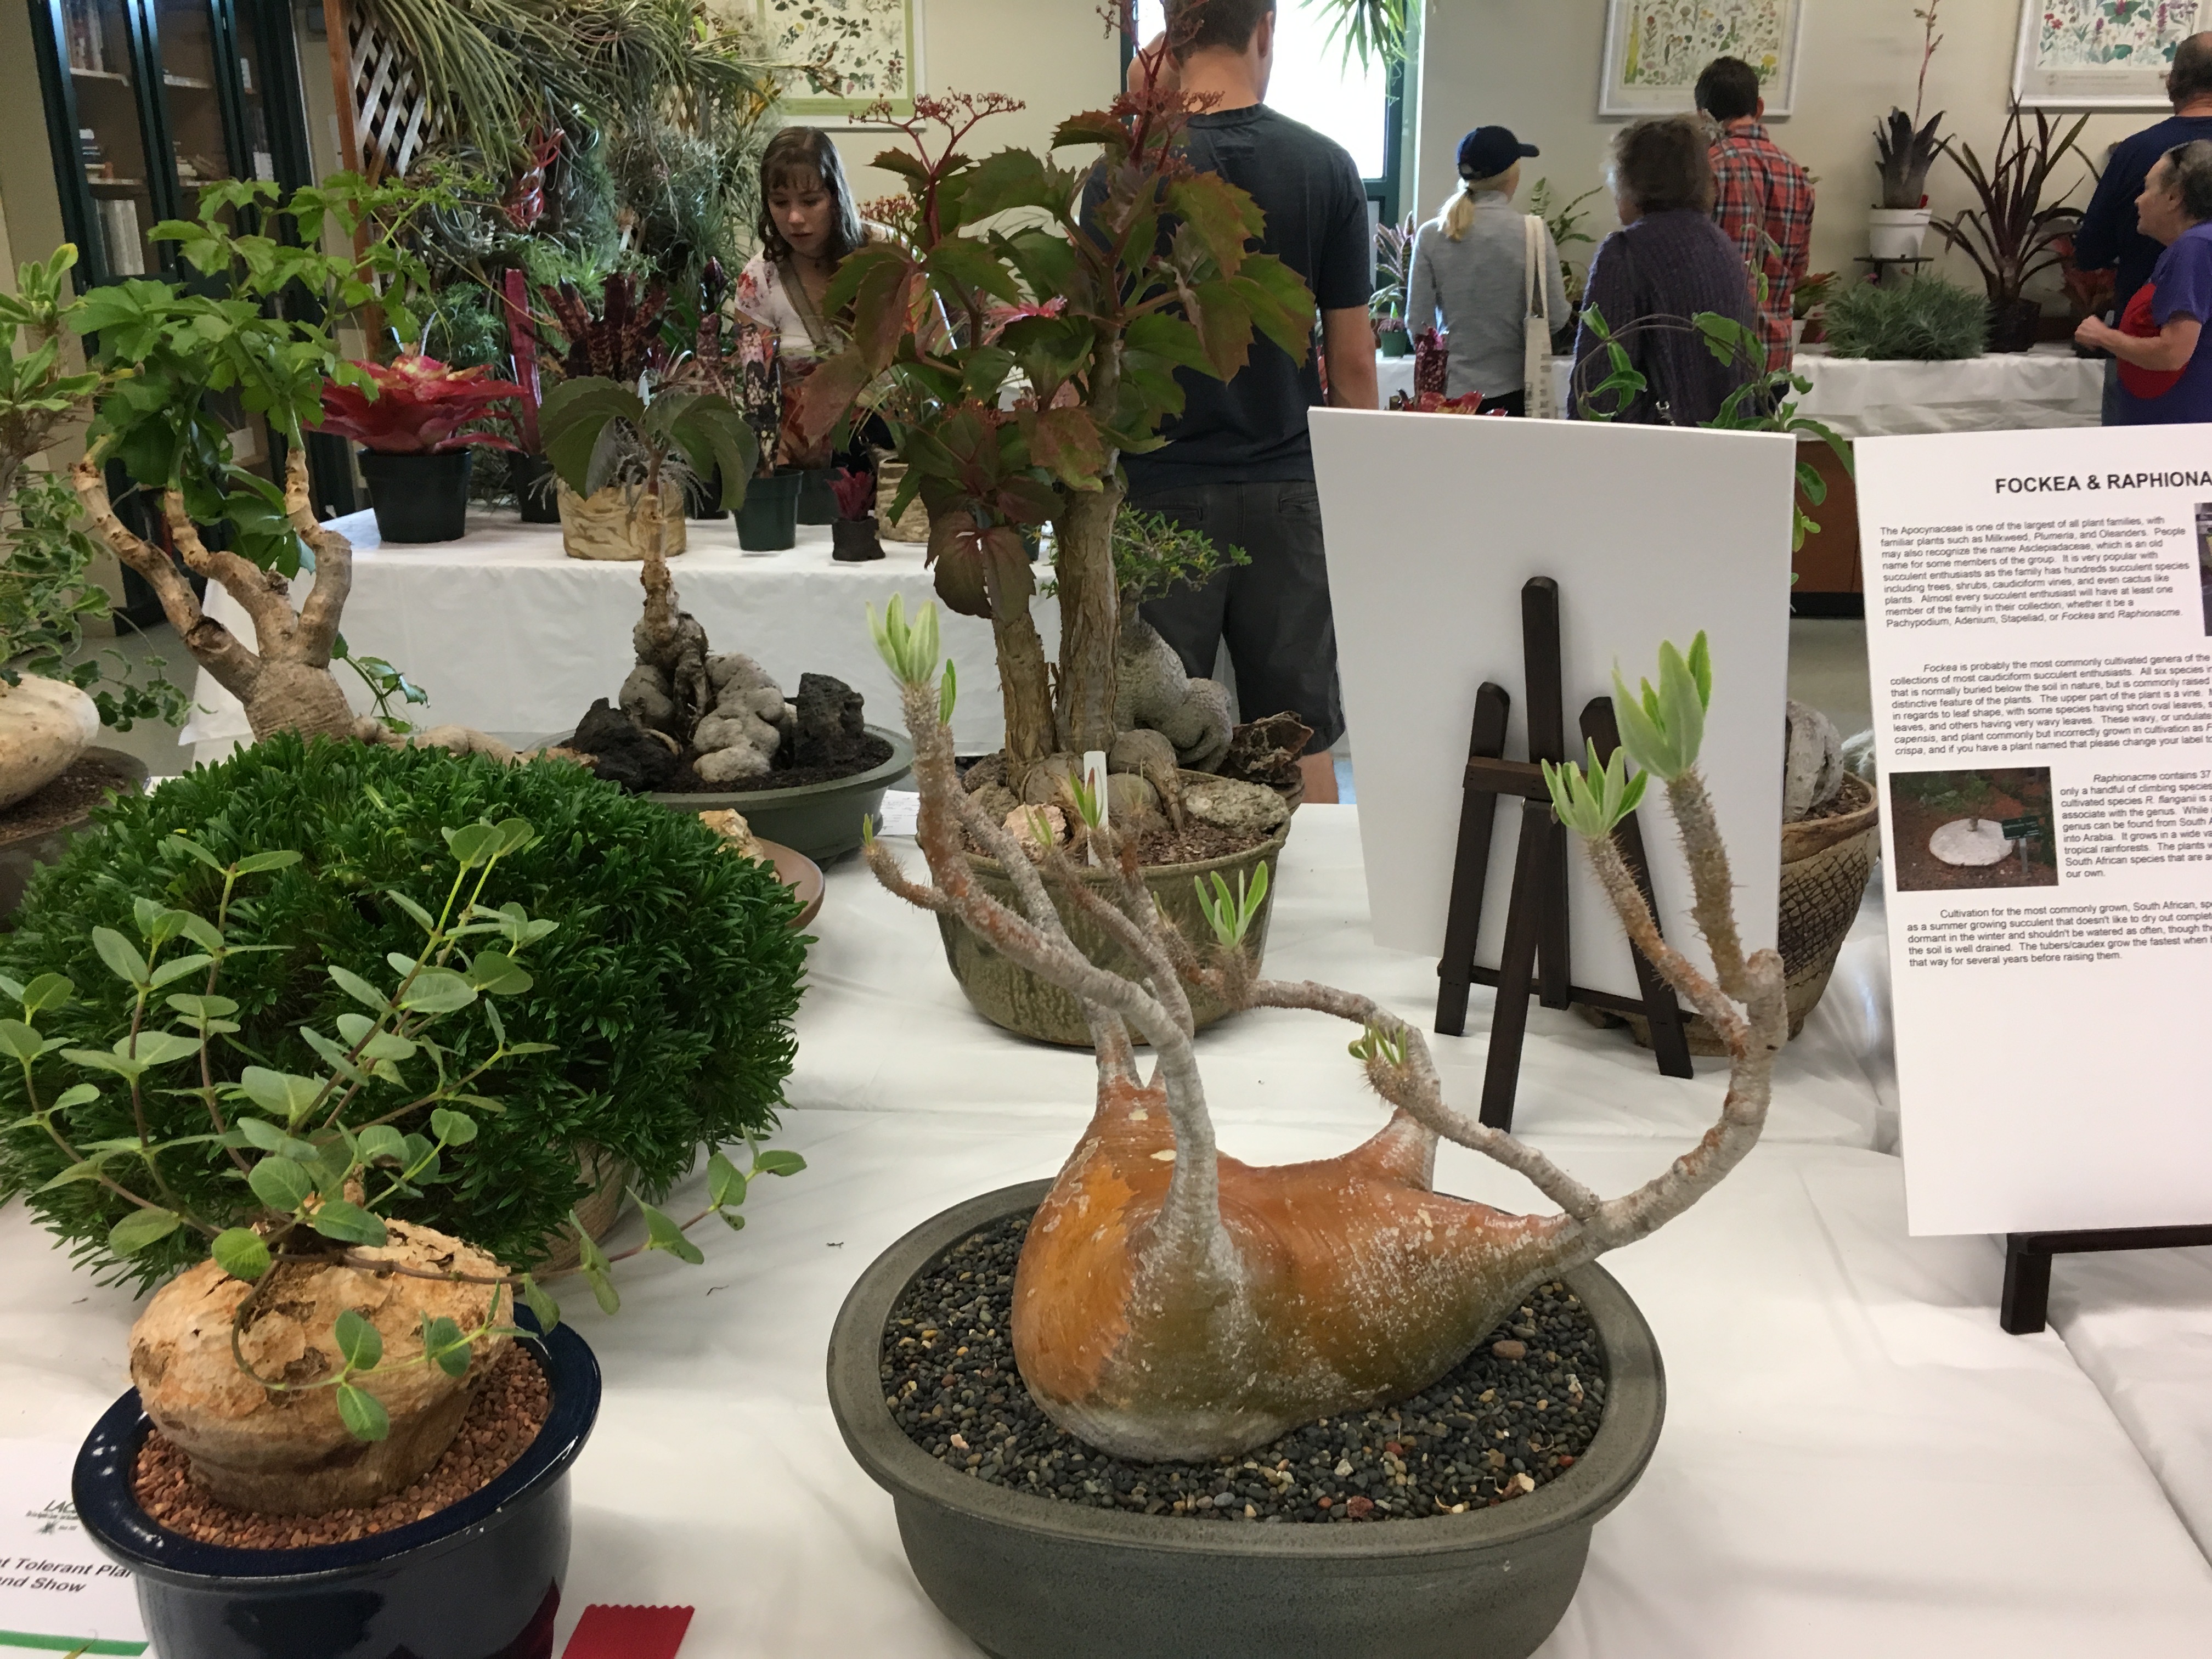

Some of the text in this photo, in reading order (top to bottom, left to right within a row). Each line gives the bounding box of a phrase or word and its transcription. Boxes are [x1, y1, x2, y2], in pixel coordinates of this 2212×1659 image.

[1995, 470, 2212, 494] FOCKEA & RAPHIONA
[1880, 527, 1898, 535] The
[1900, 526, 1963, 535] Apocynaceae
[1965, 523, 1973, 532] is
[1995, 522, 2005, 530] of
[2023, 520, 2055, 531] largest
[2057, 520, 2067, 528] of
[2068, 519, 2079, 527] all
[2081, 518, 2104, 528] plant
[2146, 515, 2165, 524] with
[1880, 538, 1914, 546] familiar
[1916, 537, 1944, 547] plants
[1946, 535, 1969, 544] such
[2079, 530, 2097, 538] and
[2098, 528, 2148, 538] Oleanders.
[2153, 526, 2186, 537] People
[1881, 551, 1901, 559] may
[1903, 549, 1923, 557] also
[1925, 547, 1970, 557] recognize
[1972, 546, 1988, 554] the
[2096, 540, 2123, 549] which
[2124, 540, 2132, 548] is
[2148, 539, 2163, 547] old
[1910, 560, 1923, 568] for
[1953, 557, 1997, 566] members
[1999, 556, 2008, 565] of
[2027, 556, 2056, 566] group.
[2062, 554, 2069, 562] It
[2070, 554, 2079, 562] is
[2081, 555, 2101, 563] very
[2102, 551, 2137, 562] popular
[2139, 550, 2158, 559] with
[1883, 572, 1927, 581] succulent
[1929, 569, 1982, 579] enthusiasts
[2014, 567, 2042, 577] family
[2044, 566, 2061, 574] has
[2063, 565, 2107, 574] hundreds
[2109, 563, 2153, 572] succulent
[2154, 561, 2190, 572] species
[1883, 583, 1925, 592] including
[1955, 580, 1990, 589] shrubs,
[1992, 579, 2045, 588] caudiciform
[2047, 578, 2075, 586] vines,
[2076, 576, 2095, 585] and
[2121, 575, 2152, 583] cactus
[2153, 573, 2169, 582] like
[1884, 596, 1914, 606] plants.
[1920, 594, 1953, 602] Almost
[1955, 594, 1980, 602] every
[1983, 591, 2027, 600] succulent
[2029, 589, 2076, 598] enthusiast
[2078, 588, 2093, 596] will
[2131, 585, 2154, 594] least
[1884, 606, 1923, 615] member
[1926, 605, 1936, 613] of
[1937, 605, 1952, 613] the
[1954, 603, 1982, 613] family
[1994, 602, 2015, 611] their
[2017, 601, 2064, 610] collection,
[2066, 599, 2103, 608] whether
[2113, 598, 2125, 606] be
[1886, 617, 1951, 628] Pachypodium,
[1954, 616, 1998, 624] Adenium,
[2061, 611, 2096, 620] Fockea
[2097, 610, 2115, 618] and
[2117, 609, 2182, 619] Raphionacme.
[1923, 663, 1957, 672] Fockea
[1970, 661, 2010, 672] probably
[2012, 661, 2027, 669] the
[2029, 659, 2052, 668] most
[2054, 657, 2102, 667] commonly
[2103, 656, 2148, 665] cultivated
[2149, 656, 2182, 665] genera
[2195, 653, 2210, 662] the
[1889, 675, 1939, 685] collections
[1941, 674, 1950, 682] of
[1953, 674, 1976, 682] most
[1977, 672, 2031, 681] caudiciform
[2033, 670, 2077, 679] succulent
[2079, 668, 2134, 678] enthusiasts.
[2140, 667, 2152, 675] All
[2169, 665, 2204, 675] species
[2092, 770, 2211, 784] Raphionacme contains 37
[1939, 909, 1989, 918] Cultivation
[2023, 906, 2047, 915] most
[2049, 904, 2097, 914] commonly
[2098, 905, 2130, 913] grown,
[2132, 901, 2160, 910] South
[2162, 901, 2198, 909] African,
[1908, 946, 1923, 955] the
[1926, 945, 1942, 953] soil
[1954, 944, 1973, 952] well
[1975, 943, 2013, 952] drained.
[2019, 942, 2038, 950] The
[2039, 940, 2105, 950] tubers/caudex
[2107, 940, 2130, 949] grow
[2149, 937, 2181, 945] fastest
[2182, 936, 2208, 944] when
[1909, 951, 2121, 967] that way for several years before raising them.
[15, 1558, 93, 1575] Tolerant
[0, 1576, 87, 1593] nd Show
